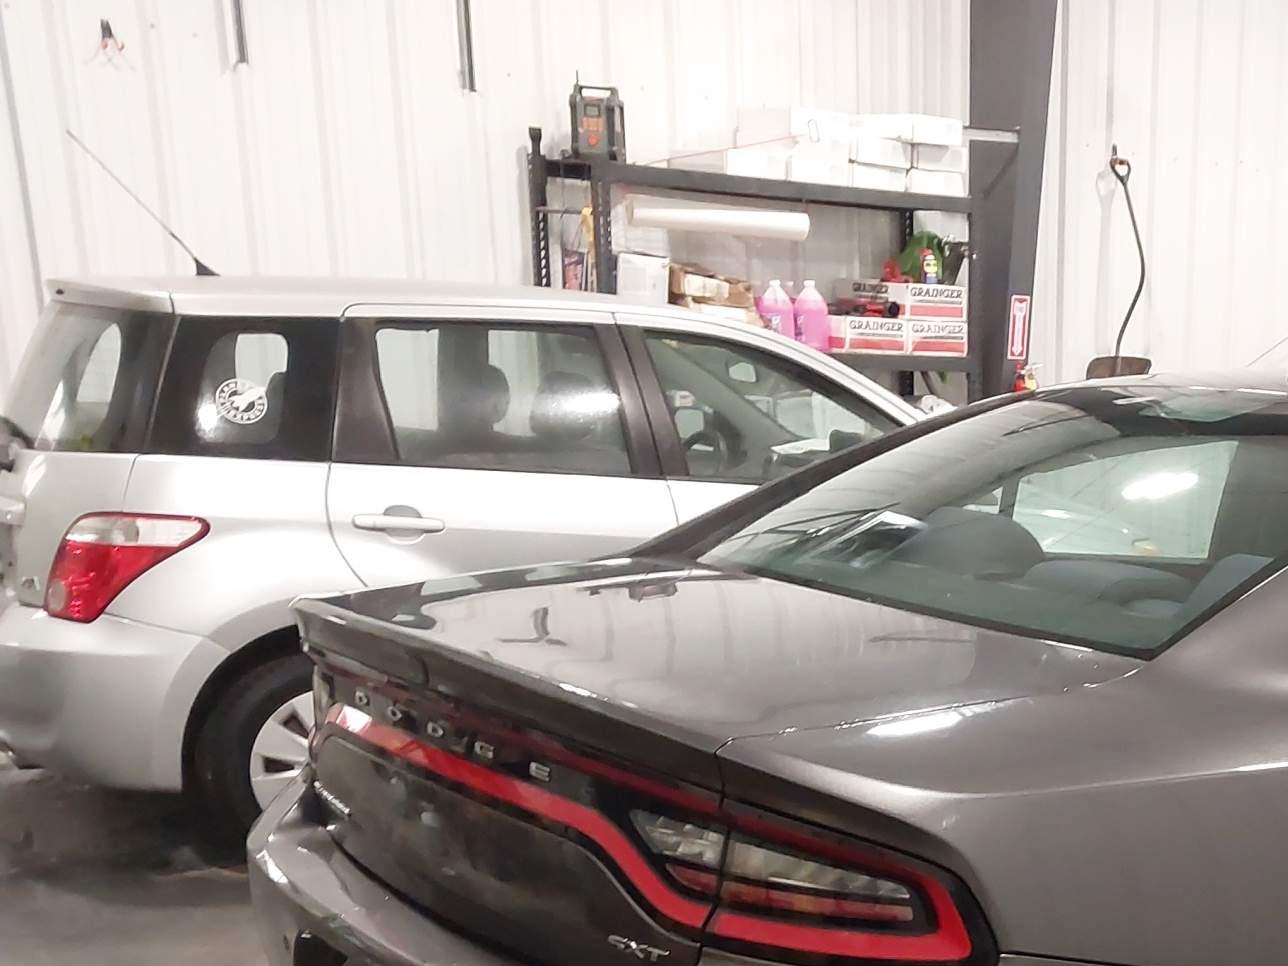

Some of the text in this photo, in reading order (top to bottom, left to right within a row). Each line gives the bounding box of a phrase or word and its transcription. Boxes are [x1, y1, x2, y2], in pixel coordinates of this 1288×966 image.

[910, 287, 963, 299] GRAINGER
[848, 319, 904, 332] GRAINGER
[911, 323, 965, 335] GRAINGER
[607, 935, 671, 962] SXT
